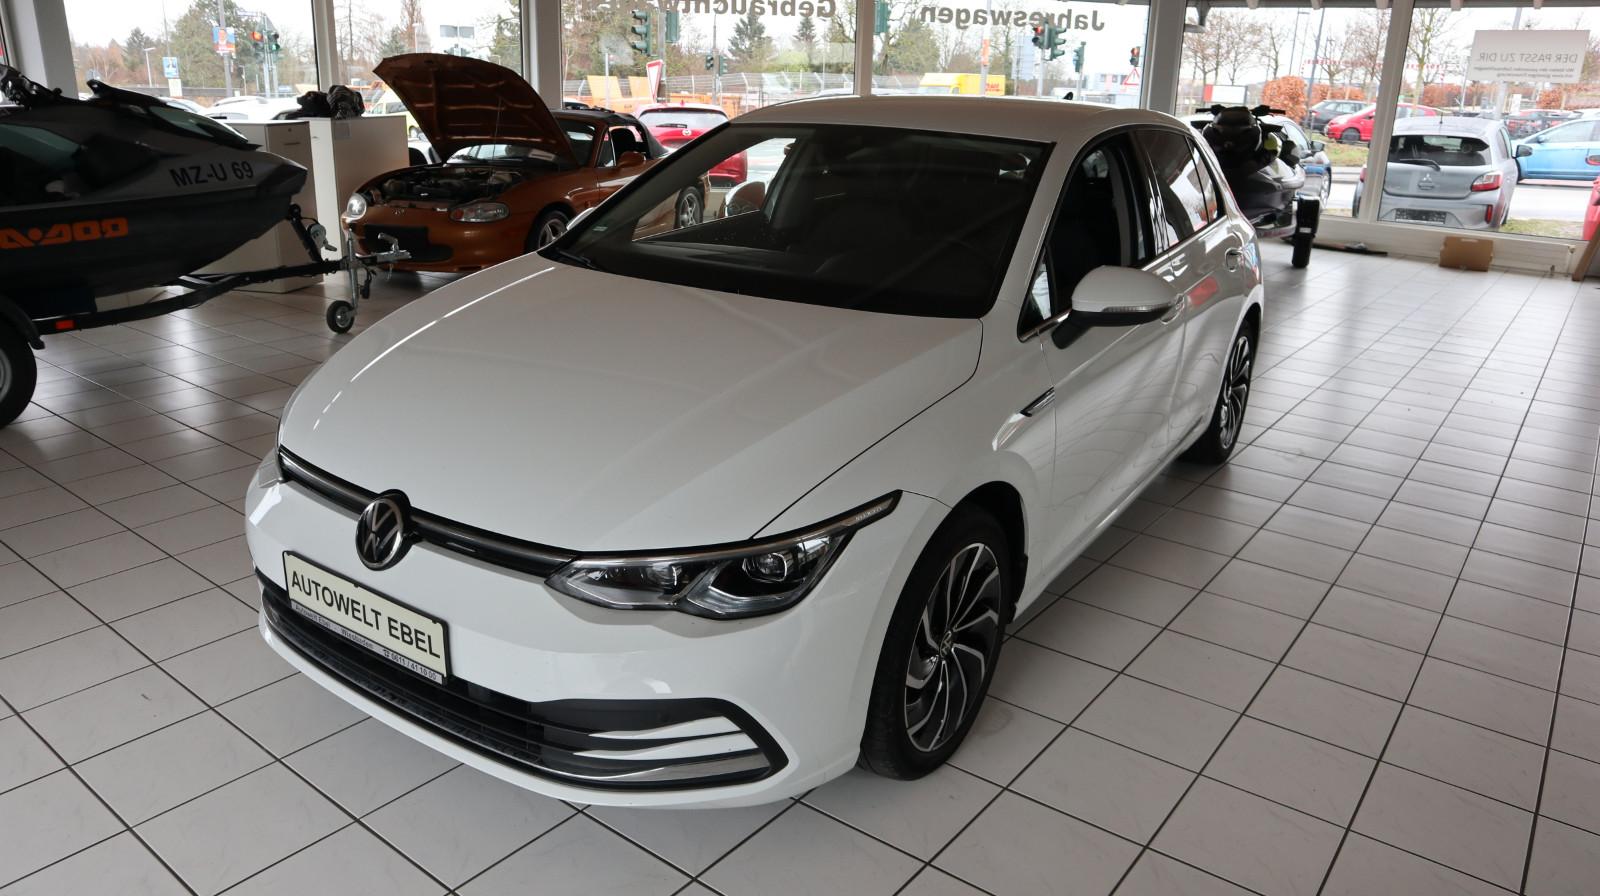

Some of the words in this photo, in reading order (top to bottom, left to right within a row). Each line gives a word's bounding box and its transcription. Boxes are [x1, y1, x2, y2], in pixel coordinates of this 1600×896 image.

[169, 163, 227, 187] MZ-U
[231, 161, 254, 179] 69
[291, 570, 381, 630] AUTOWELT
[387, 616, 441, 659] EBEL
